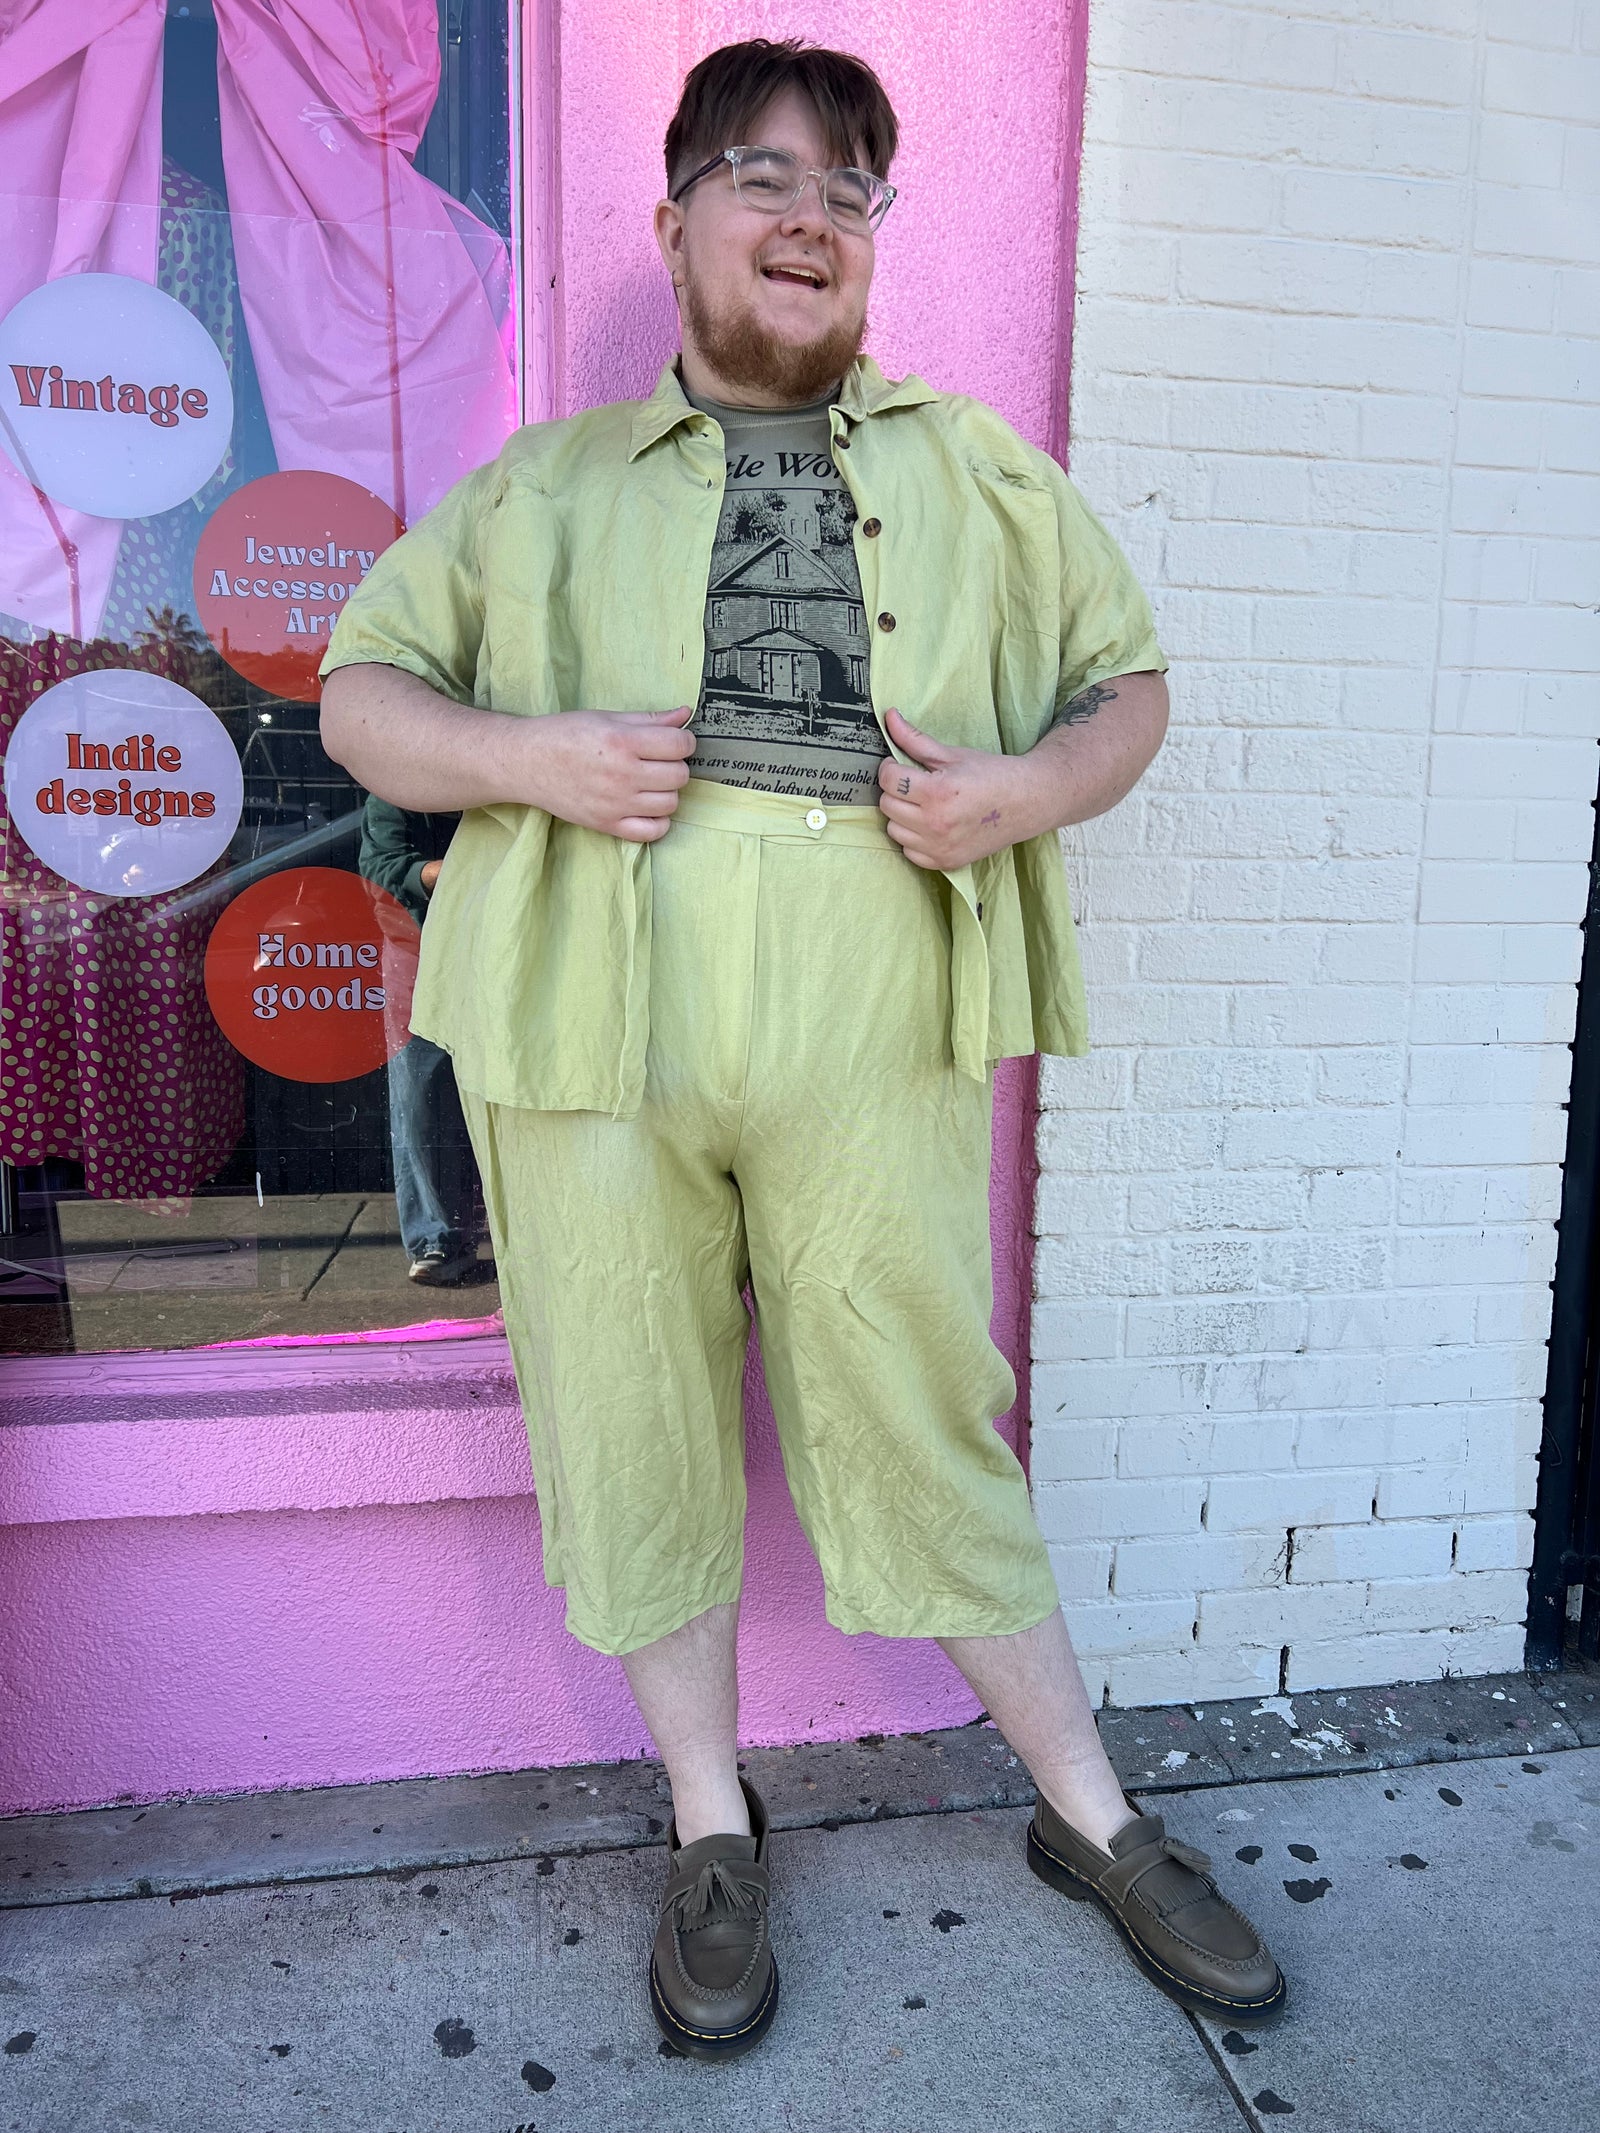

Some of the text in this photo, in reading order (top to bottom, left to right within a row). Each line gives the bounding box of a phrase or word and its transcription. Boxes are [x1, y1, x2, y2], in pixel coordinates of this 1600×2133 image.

[8, 364, 209, 428] Vintage
[244, 536, 375, 577] Jewelry
[65, 732, 182, 773] Indie
[706, 758, 730, 768] are
[731, 759, 766, 773] some
[766, 763, 819, 779] natures
[819, 767, 840, 781] too
[841, 769, 872, 785] noble
[36, 778, 216, 827] designs
[720, 776, 751, 789] and
[751, 779, 772, 793] too
[772, 779, 803, 796] lofty
[804, 785, 818, 798] to
[256, 932, 379, 969] Home
[252, 977, 387, 1020] goods
